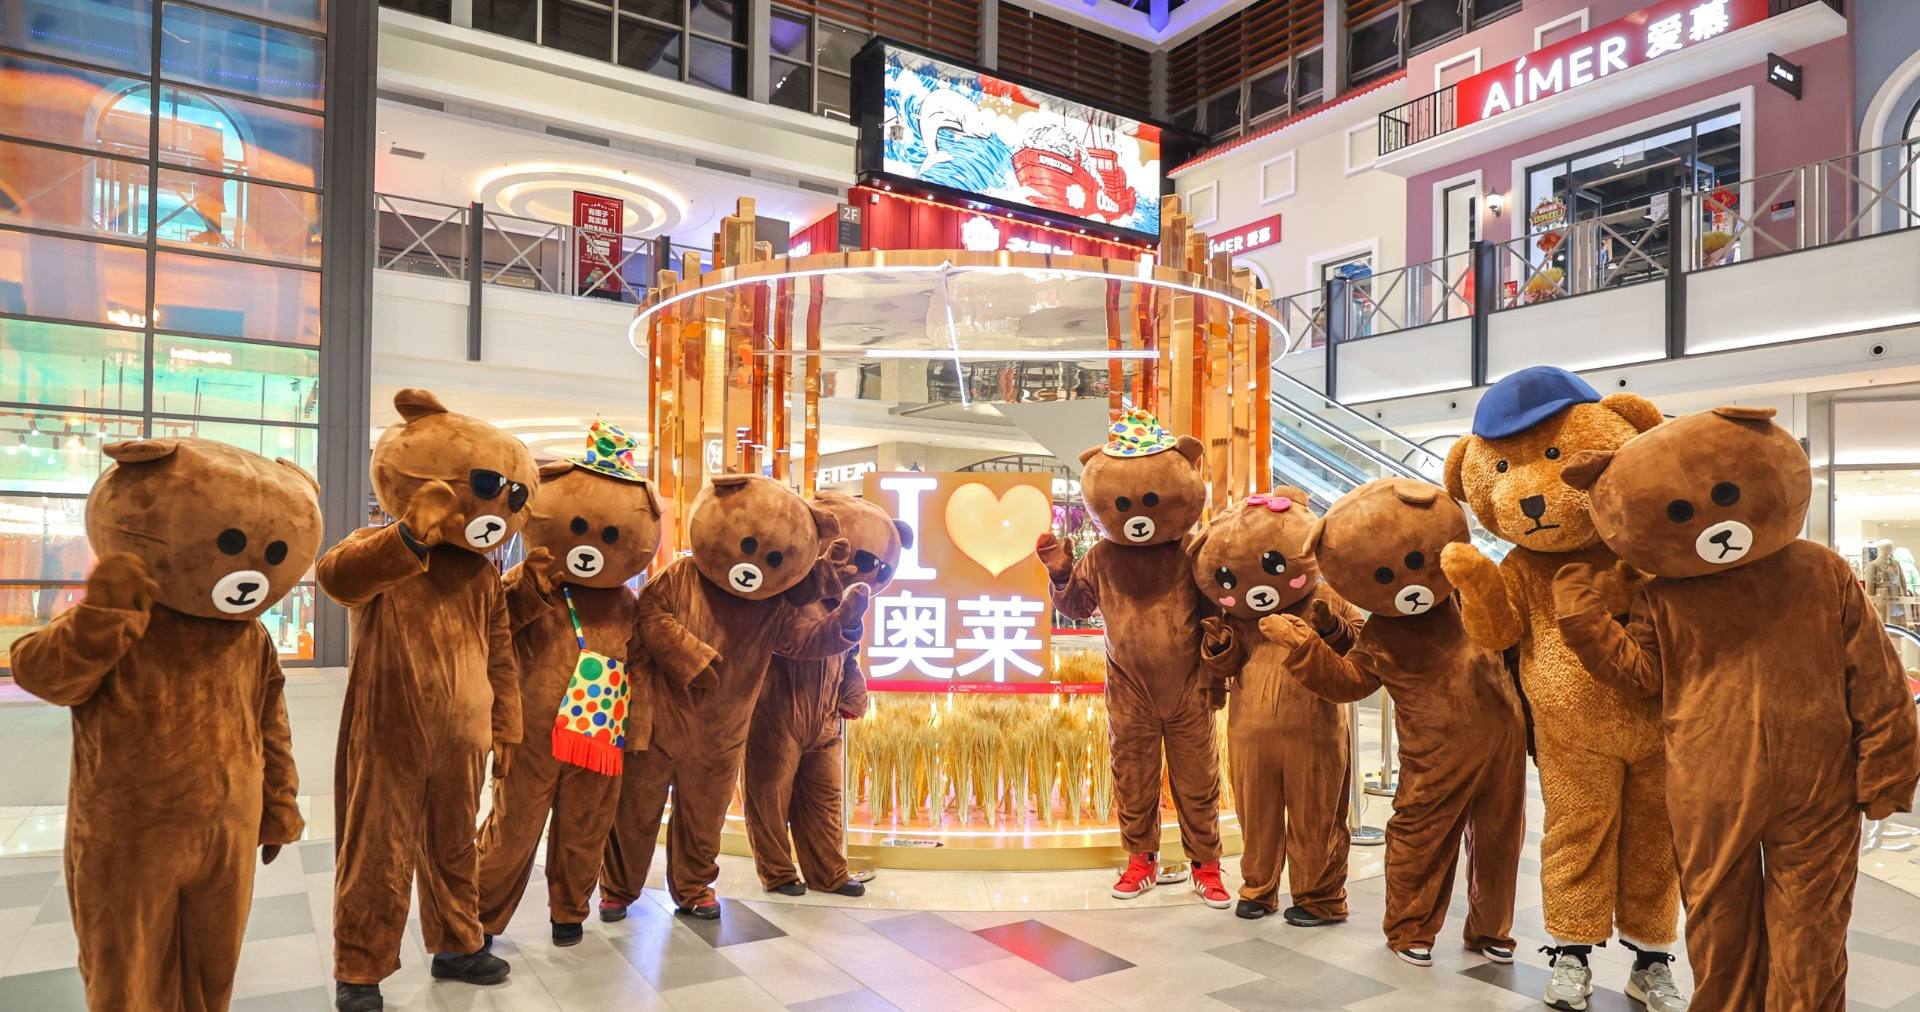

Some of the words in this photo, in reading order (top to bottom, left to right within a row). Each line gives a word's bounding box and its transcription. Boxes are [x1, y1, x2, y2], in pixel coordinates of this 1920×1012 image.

[1646, 0, 1729, 58] 爱慕
[843, 207, 859, 221] 2F
[880, 477, 938, 580] I
[867, 589, 1044, 682] 奥莱
